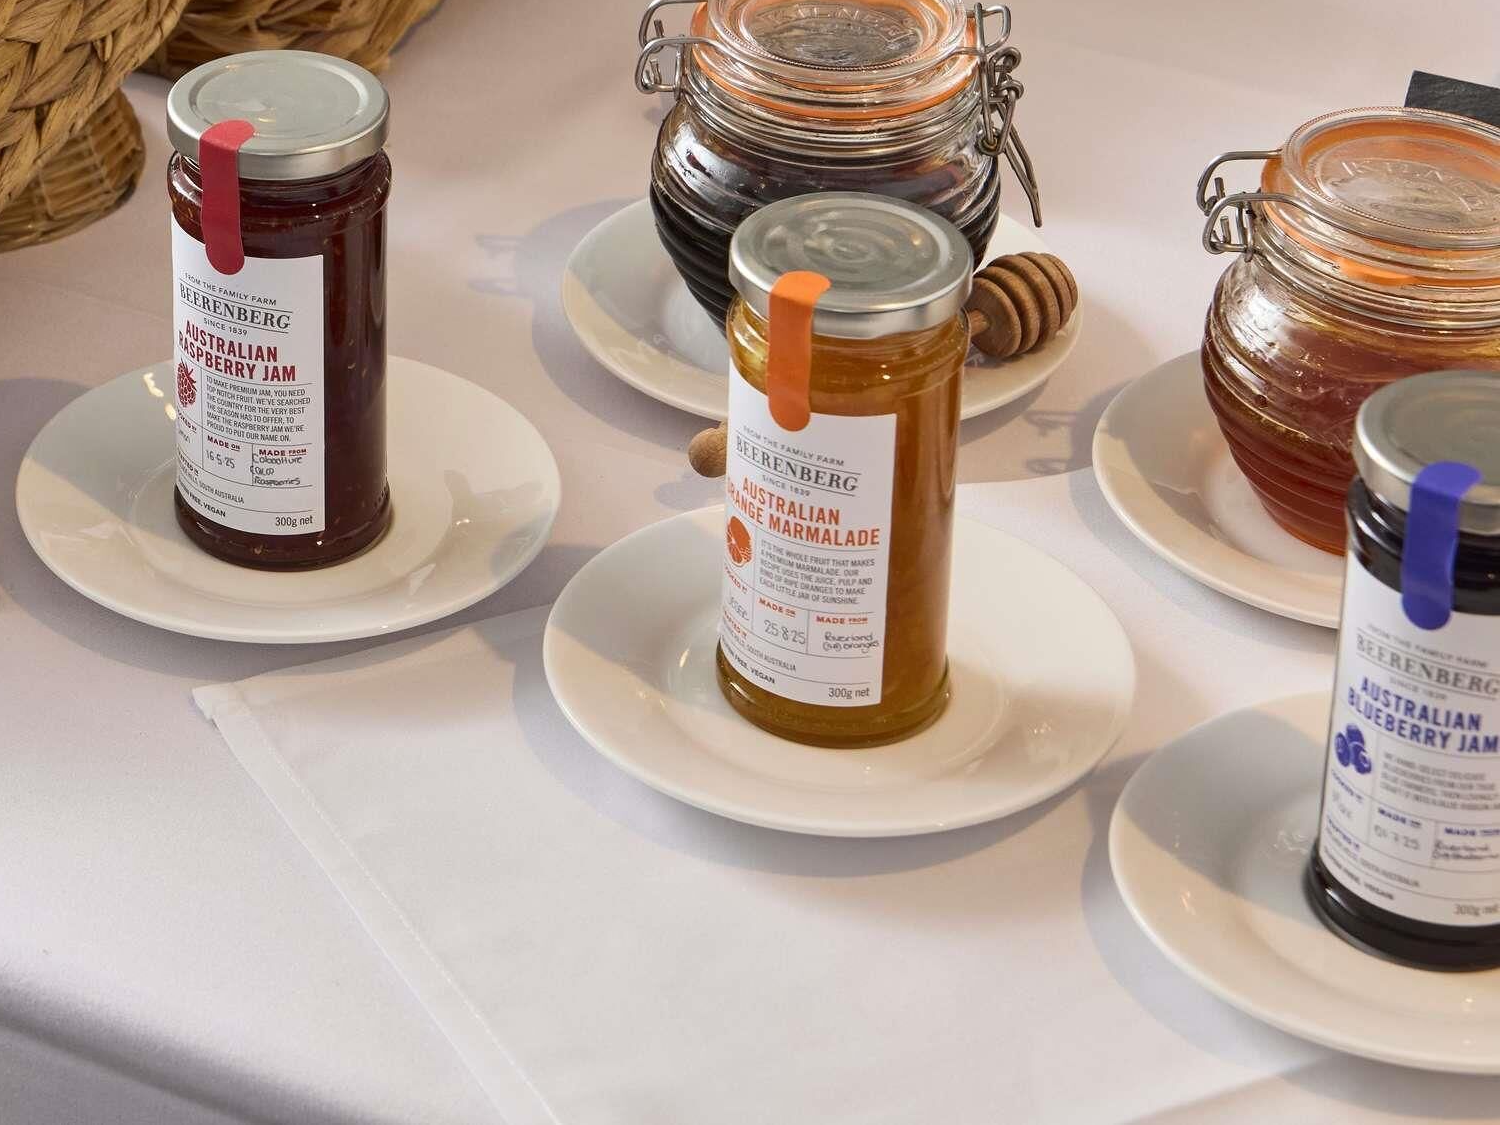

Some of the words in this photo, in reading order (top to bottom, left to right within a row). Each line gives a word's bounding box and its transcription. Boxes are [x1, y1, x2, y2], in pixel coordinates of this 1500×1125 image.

[203, 281, 216, 292] THE
[218, 287, 249, 300] FAMILY
[252, 295, 277, 306] FARM
[180, 282, 291, 329] BEERENBERG
[203, 317, 226, 331] SINCE
[229, 326, 248, 336] 1839
[186, 320, 277, 362] AUSTRALIAN
[179, 330, 256, 379] RASPBERRY
[262, 365, 296, 382] JAM
[206, 384, 216, 394] TOP
[217, 388, 236, 400] NOTCH
[276, 397, 311, 407] SEARCHED
[214, 378, 229, 390] MAKE
[229, 382, 257, 395] PREMIUM
[258, 388, 274, 398] JAM,
[273, 389, 287, 397] YOU
[288, 388, 306, 397] NEED
[217, 398, 244, 411] COUNTRY
[244, 404, 257, 413] FOR
[271, 407, 288, 415] VERY
[289, 406, 306, 415] BEST
[217, 406, 240, 418] SEASON
[240, 413, 253, 422] HAS
[286, 416, 295, 424] TO
[206, 411, 221, 422] MAKE
[222, 417, 233, 426] THE
[233, 420, 270, 433] RASPBERRY
[270, 425, 284, 433] JAM
[206, 419, 225, 432] PROUD
[226, 426, 233, 435] TO
[233, 428, 245, 437] PUT
[245, 431, 260, 440] OUR
[260, 434, 279, 442] NAME
[207, 435, 230, 449] MADE
[763, 436, 778, 448] THE
[780, 443, 814, 459] FAMILY
[816, 454, 844, 466] FARM
[736, 435, 859, 492] BEERENBERG
[762, 474, 786, 489] SINCE
[214, 488, 244, 504] AUSTRALIA
[743, 476, 840, 526] AUSTRALIAN
[203, 502, 226, 517] VEGAN
[275, 516, 297, 528] 300g
[299, 515, 313, 525] net
[768, 513, 880, 547] MARMALADE
[810, 555, 830, 566] FRUIT
[831, 558, 849, 567] THAT
[850, 558, 876, 567] MAKES
[800, 581, 833, 594] ORANGES
[845, 587, 867, 595] MAKE
[838, 577, 857, 586] PULP
[858, 577, 873, 585] AND
[759, 597, 783, 613] MADE
[816, 615, 844, 624] MADE
[750, 666, 775, 684] VEGAN
[828, 687, 853, 700] 300g
[855, 687, 870, 698] net
[1362, 676, 1481, 731] AUSTRALIAN
[1348, 686, 1452, 749] BLUEBERRY
[1457, 734, 1499, 753] JAM
